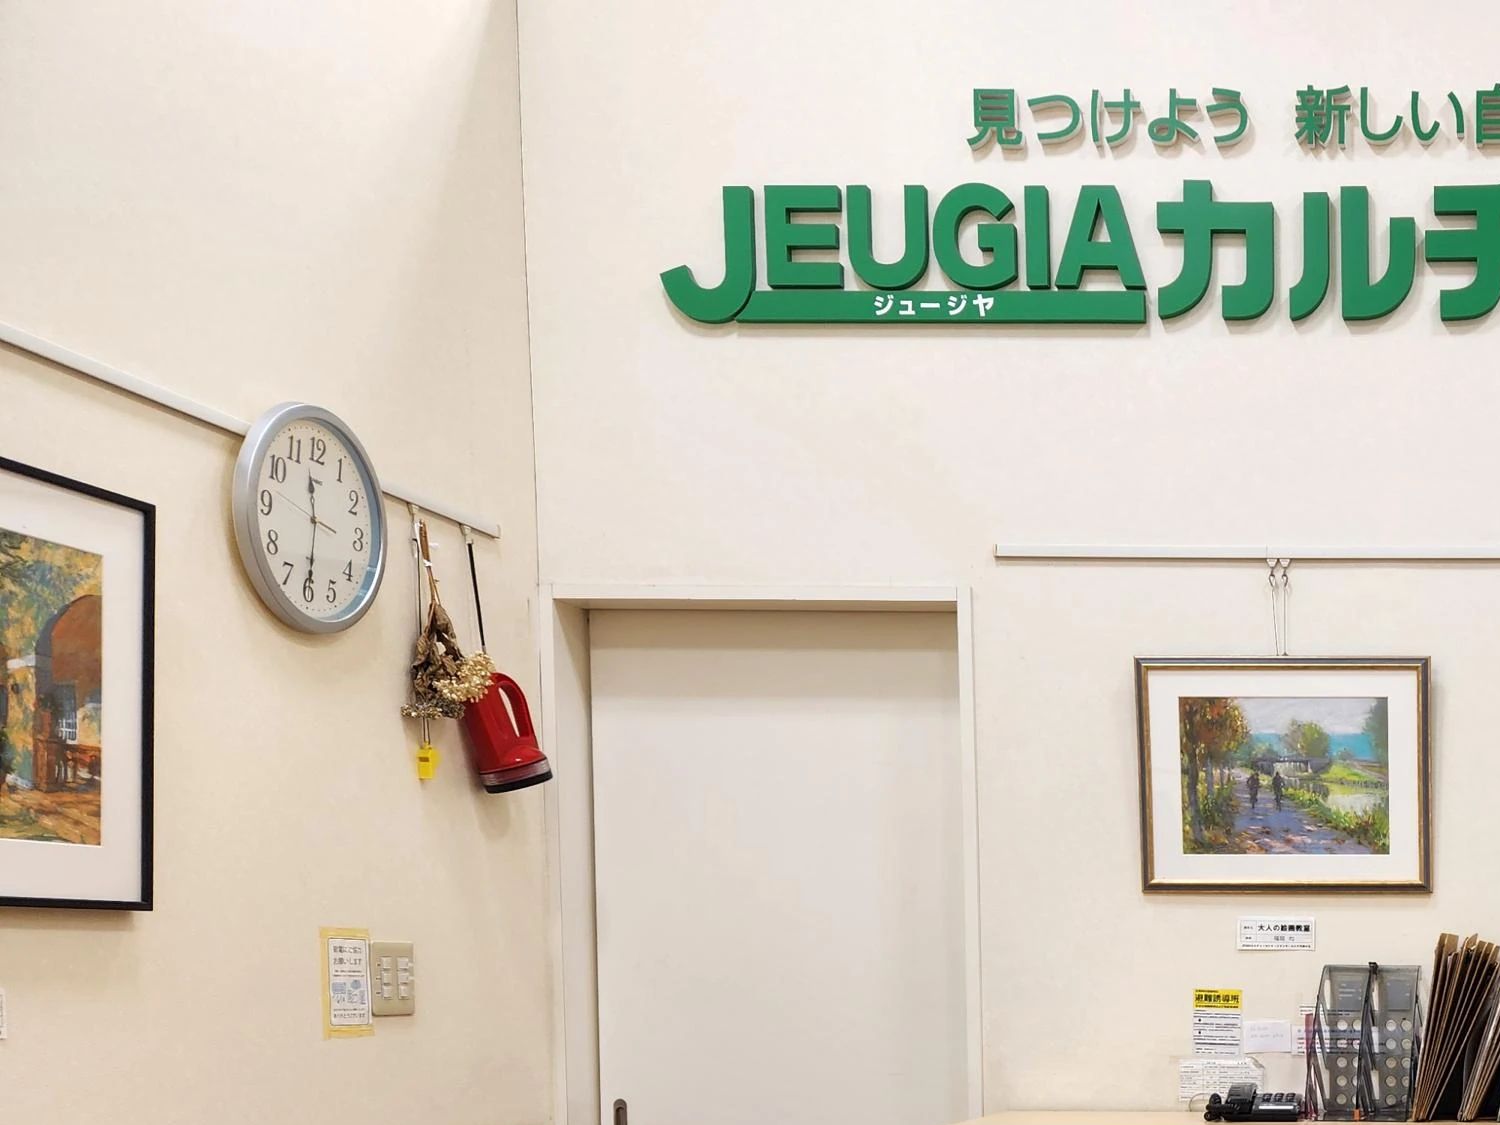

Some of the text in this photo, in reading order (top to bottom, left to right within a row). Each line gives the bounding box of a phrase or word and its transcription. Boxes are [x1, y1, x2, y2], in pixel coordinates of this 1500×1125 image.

[967, 86, 1251, 148] 見つけよう
[287, 435, 302, 464] 11
[309, 437, 327, 466] 12
[269, 454, 287, 483] 10
[336, 458, 344, 483] 1
[260, 489, 273, 515] 9
[348, 490, 359, 515] 2
[266, 529, 279, 555] 8
[352, 527, 364, 552] 3
[281, 561, 294, 585] 7
[342, 559, 354, 582] 4
[302, 577, 314, 602] 6
[326, 579, 337, 603] 5
[1257, 924, 1310, 932] 大人の絵画教室
